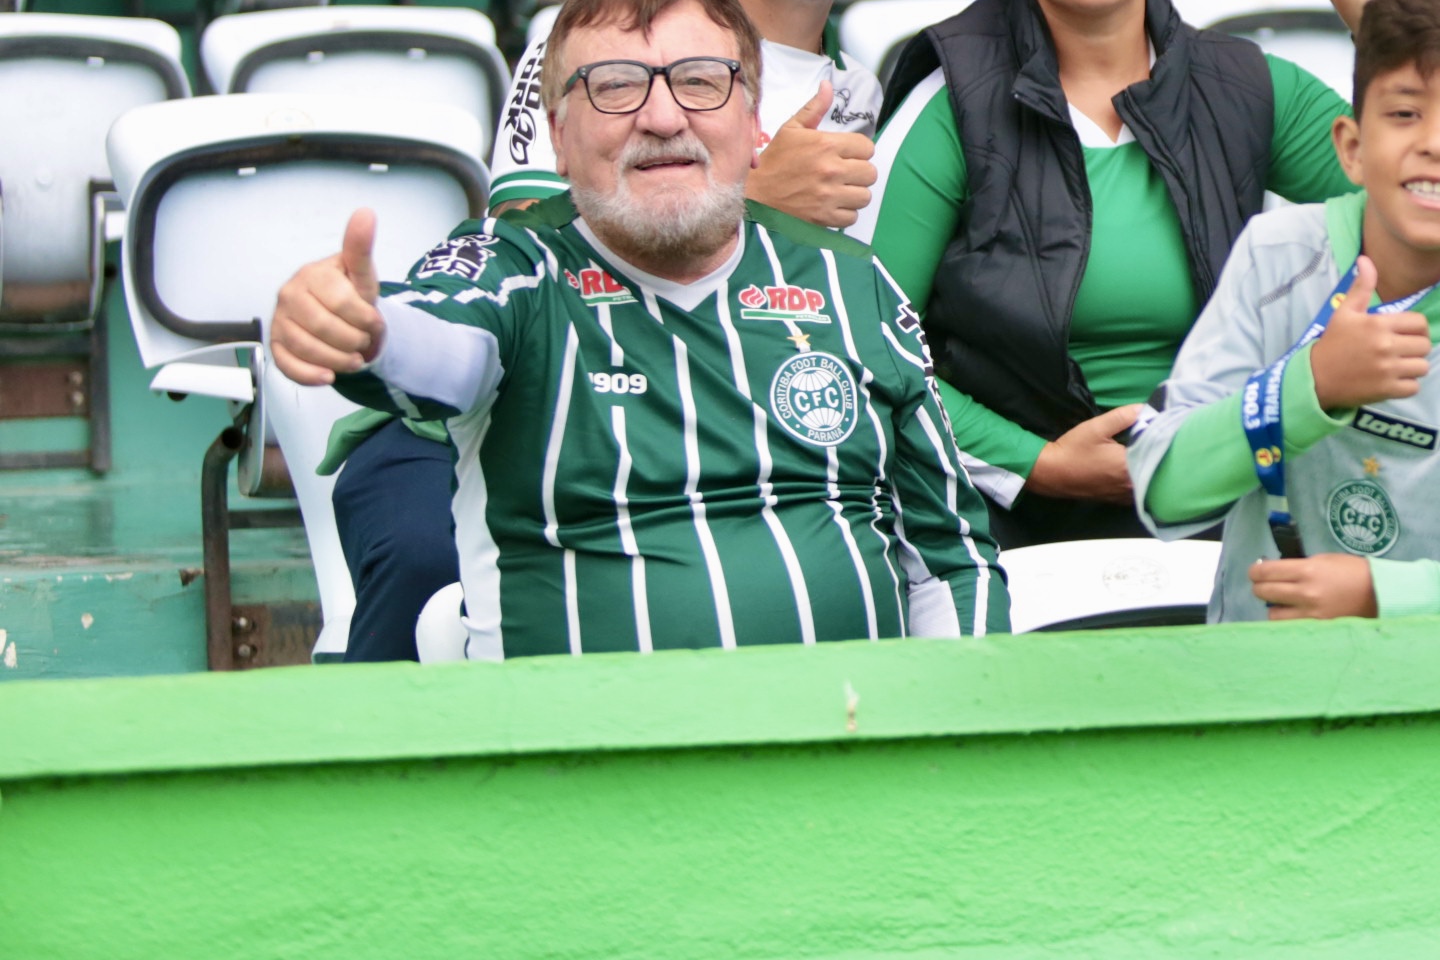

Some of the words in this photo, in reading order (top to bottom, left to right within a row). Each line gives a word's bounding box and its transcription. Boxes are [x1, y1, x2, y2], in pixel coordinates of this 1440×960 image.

[765, 286, 824, 313] RDP
[776, 370, 794, 419] CORITIBA
[790, 357, 817, 373] FOOT
[820, 358, 843, 380] BALL
[841, 380, 853, 410] CLUB
[794, 386, 840, 412] CFC
[1343, 507, 1381, 533] CFC
